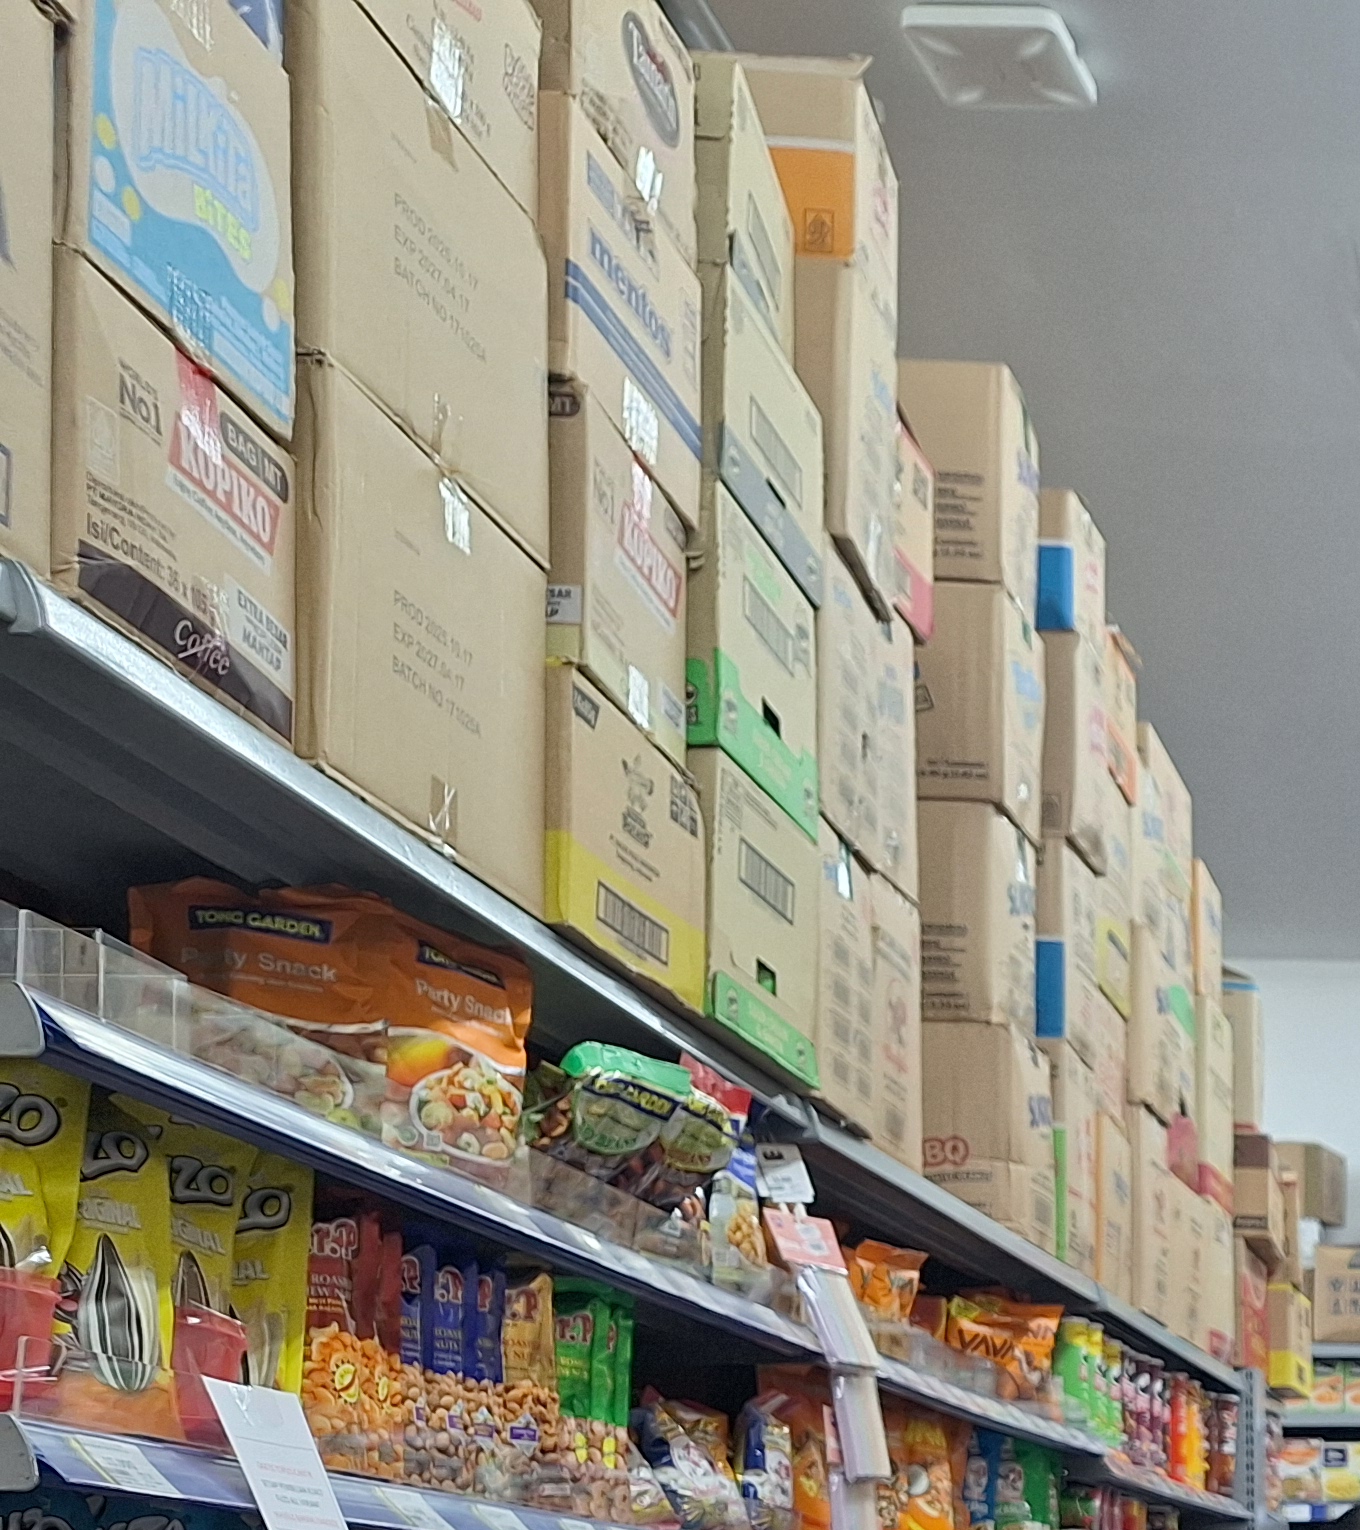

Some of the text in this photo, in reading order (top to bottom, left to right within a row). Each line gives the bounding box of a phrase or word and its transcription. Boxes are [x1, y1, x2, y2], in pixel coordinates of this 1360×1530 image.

[173, 618, 231, 677] Coffee
[195, 909, 324, 939] TONG GARDEN
[258, 952, 338, 983] Snack
[415, 978, 511, 1024] Party Snac
